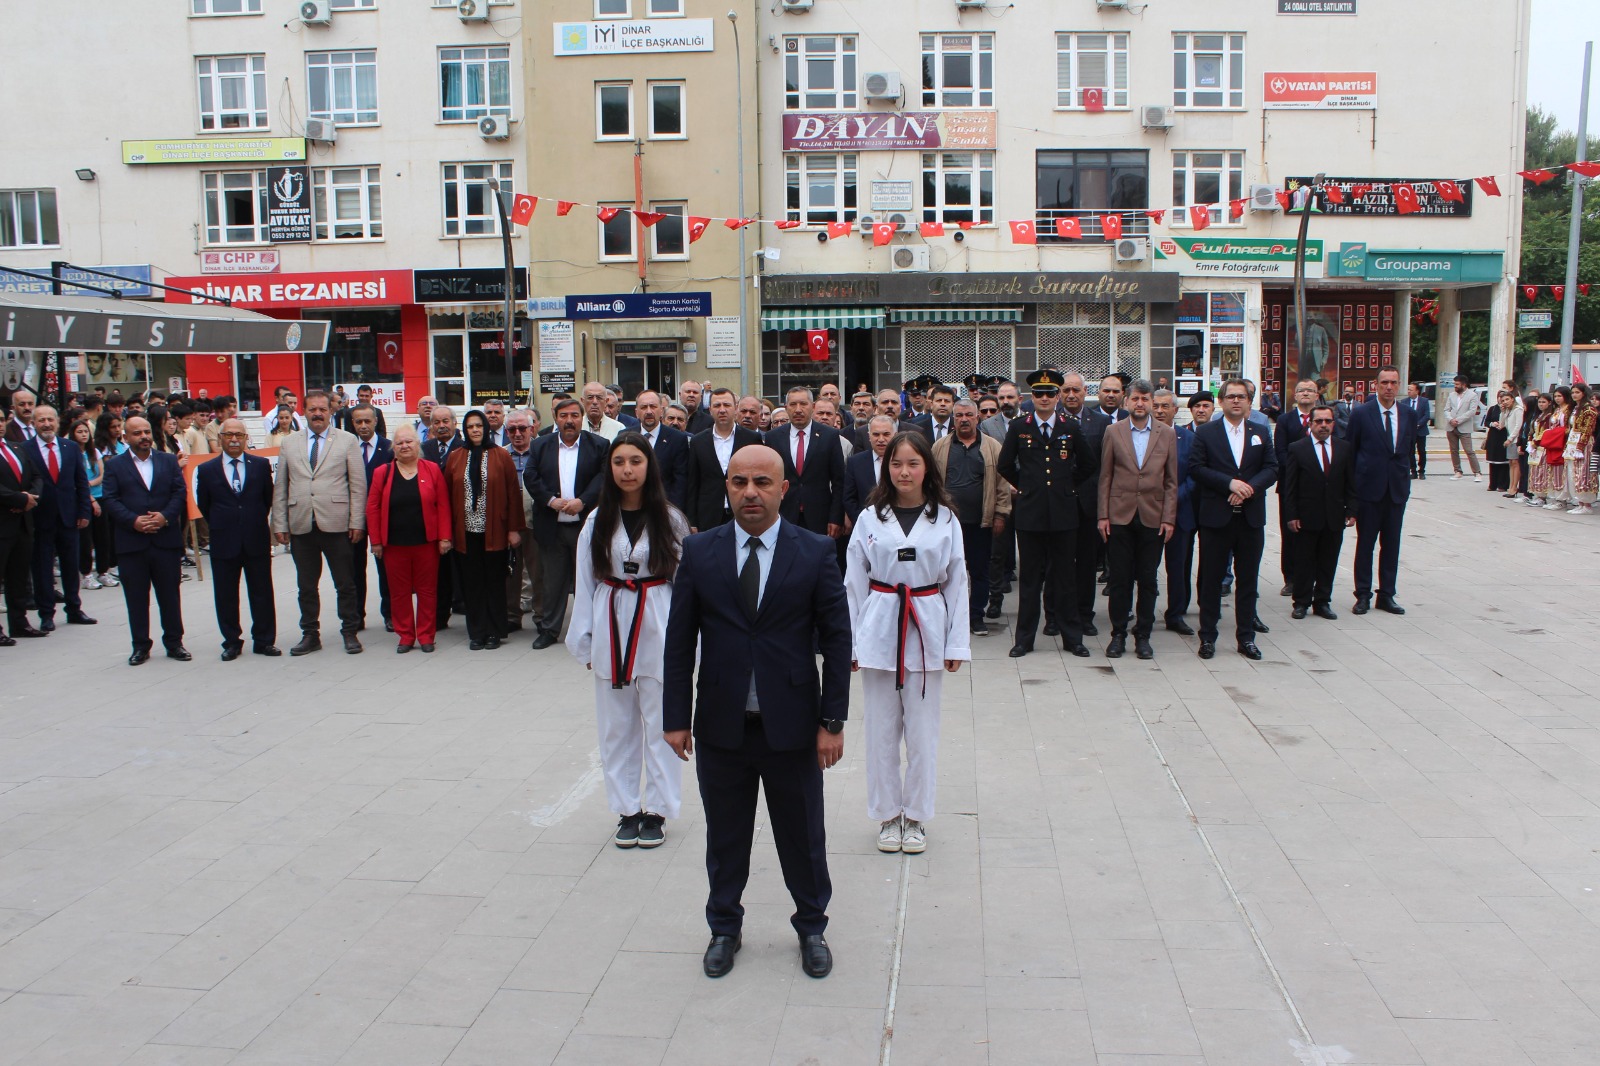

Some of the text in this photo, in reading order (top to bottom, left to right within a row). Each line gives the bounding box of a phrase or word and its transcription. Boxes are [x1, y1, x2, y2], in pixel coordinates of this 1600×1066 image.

[1309, 3, 1322, 11] OTEL
[594, 24, 615, 43] İYİ
[621, 25, 651, 35] DİNAR
[621, 36, 704, 48] İLÇE BAŞKANLIĞI
[1288, 80, 1372, 91] VATAN PARTİSİ
[792, 115, 930, 140] DAYAN
[155, 142, 211, 151] CUMHURİYET
[238, 140, 273, 149] PARTİSİ
[162, 149, 265, 160] DİNAR İLÇE BAŞKANLIĞI
[1326, 203, 1352, 213] Plan
[1364, 203, 1395, 214] Proje
[269, 215, 311, 226] AVUKAT
[223, 252, 255, 263] CHP
[1195, 262, 1280, 274] Emre Fotoğrafçılık
[1374, 257, 1451, 273] Groupama
[190, 277, 386, 304] DİNAR ECZANESİ
[576, 302, 611, 312] Allianz
[648, 305, 701, 314] Sigorta Acenteliği
[350, 396, 391, 407] ECNESİ
[395, 391, 403, 401] E
